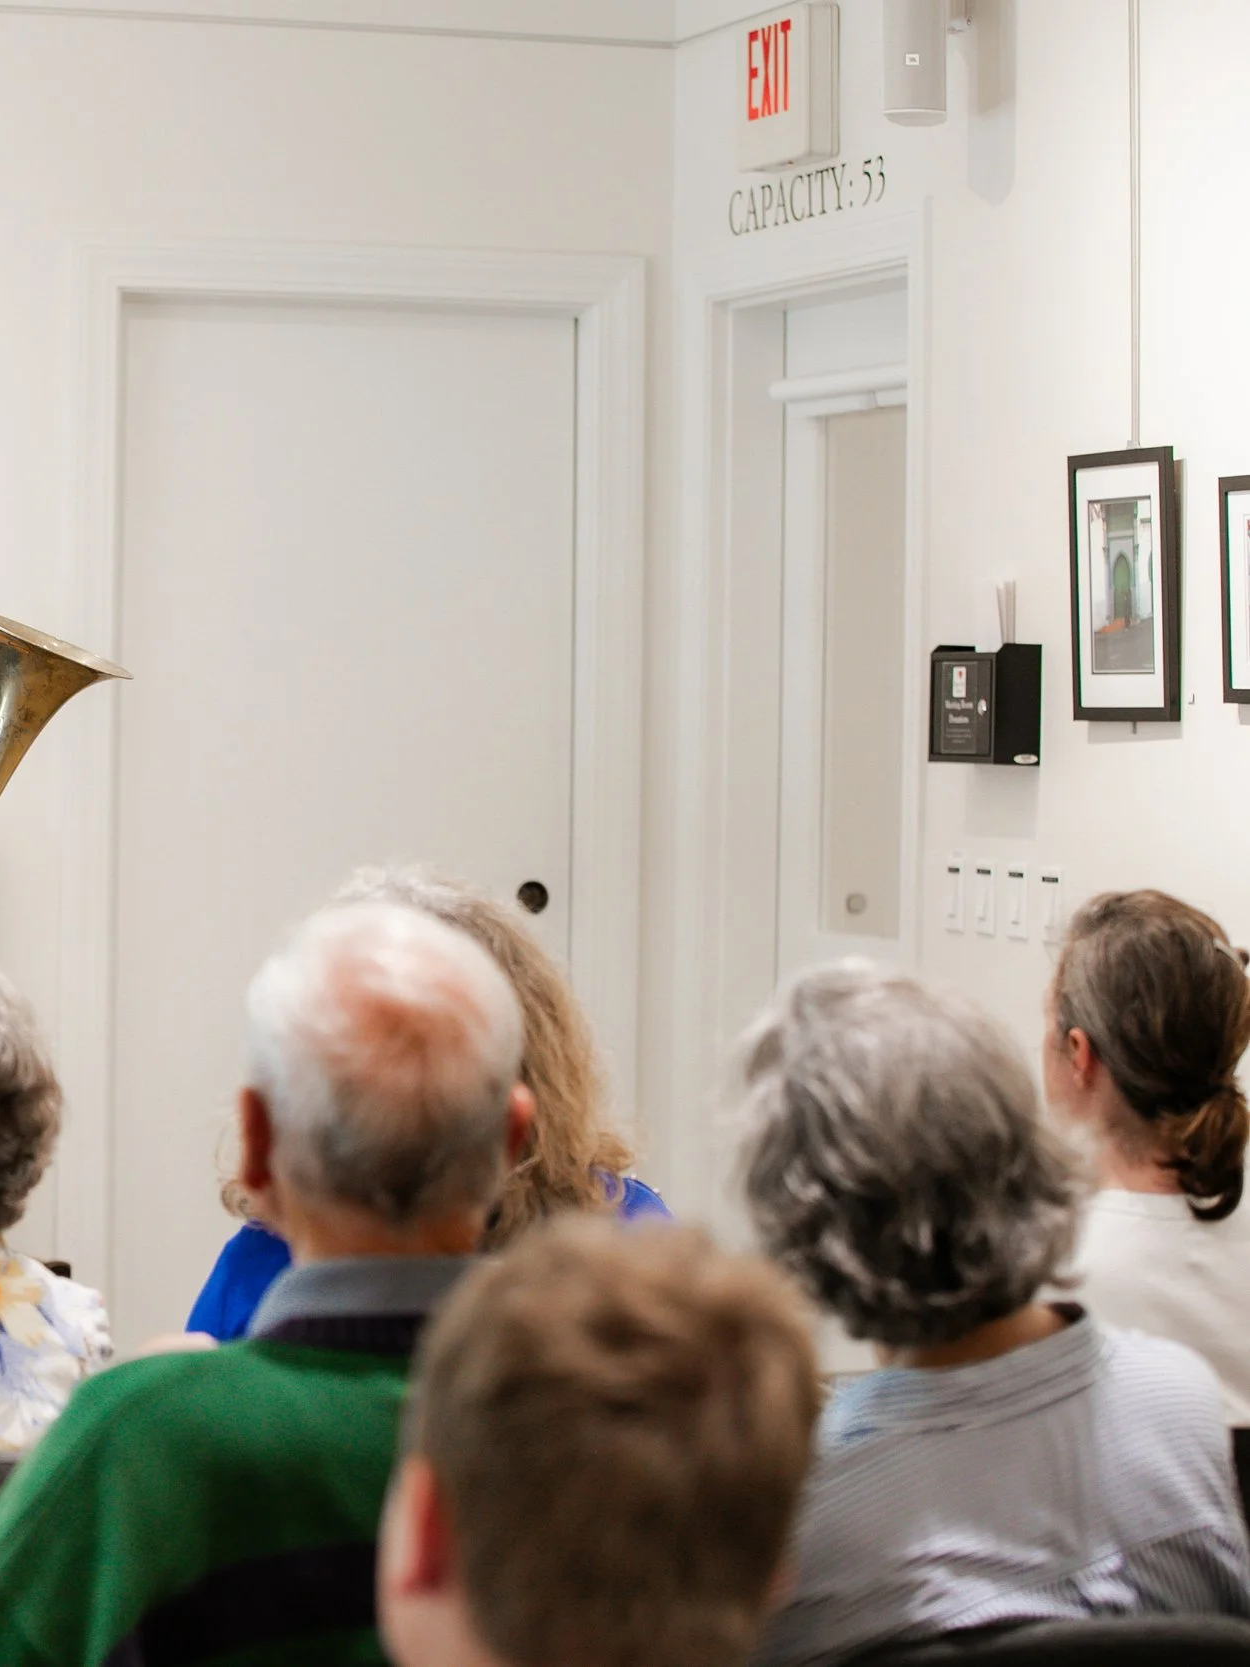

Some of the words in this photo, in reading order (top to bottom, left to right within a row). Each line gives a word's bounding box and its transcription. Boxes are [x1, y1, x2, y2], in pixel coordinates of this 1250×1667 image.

[749, 20, 791, 120] EXIT
[729, 164, 853, 236] CAPACITY:
[862, 156, 886, 206] 53
